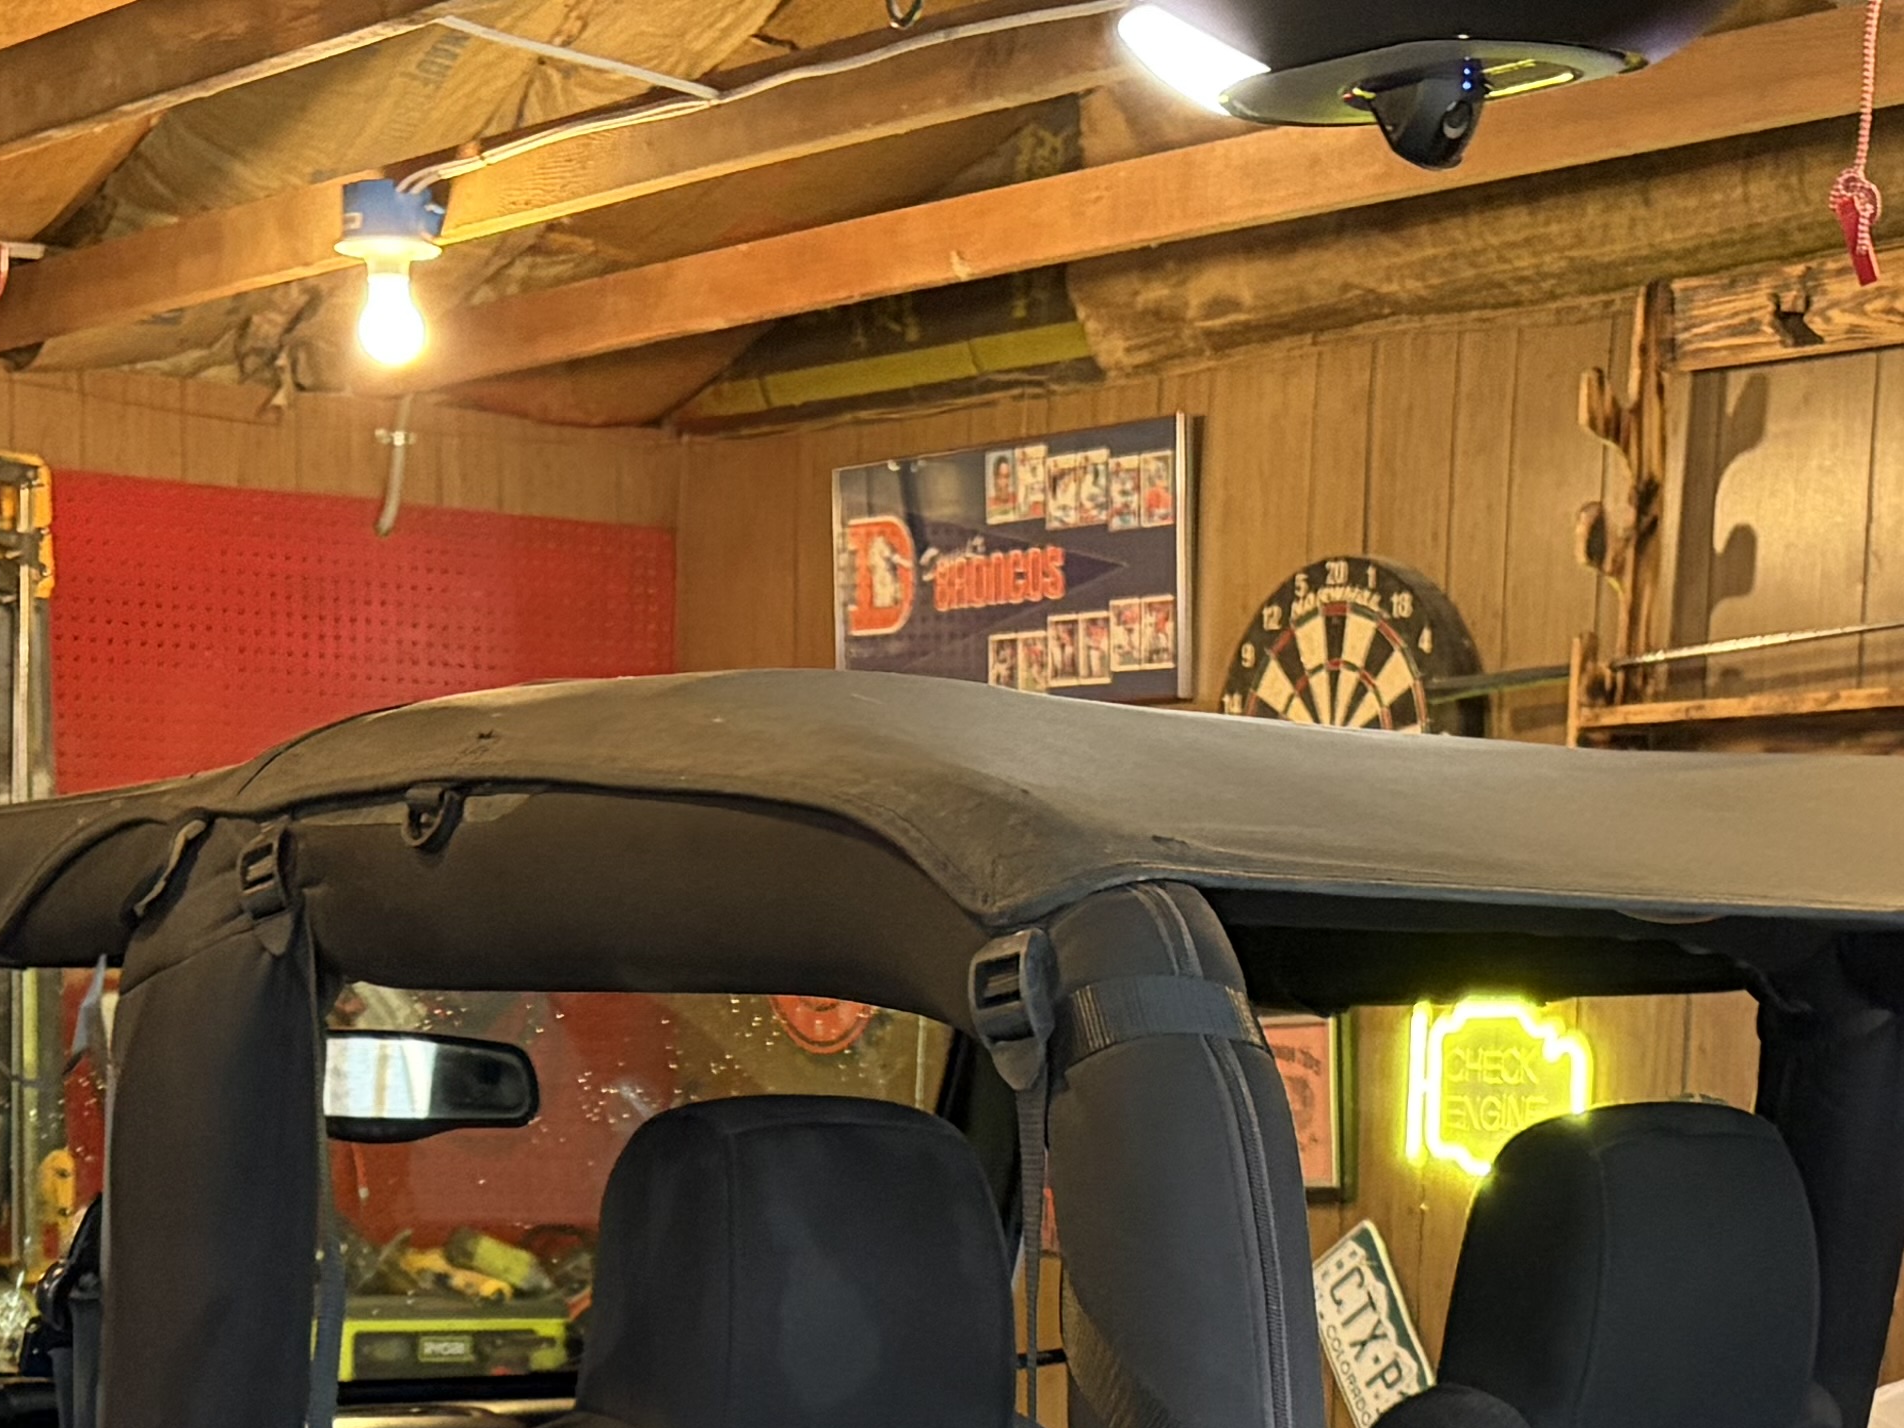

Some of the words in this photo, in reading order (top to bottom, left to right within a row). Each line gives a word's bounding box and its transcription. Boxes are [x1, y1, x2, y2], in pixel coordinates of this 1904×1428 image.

[934, 546, 1065, 612] BRONCOS
[1294, 573, 1309, 597] 5
[1325, 560, 1348, 585] 20
[1366, 564, 1377, 589] 1
[1263, 605, 1283, 630] 12
[1418, 624, 1433, 654] 4
[1241, 643, 1256, 668] 9
[1446, 1047, 1540, 1084] CHECK
[1446, 1095, 1549, 1132] ENGINE
[1329, 1266, 1408, 1398] CTX-P
[1326, 1324, 1371, 1426] COLORADO
